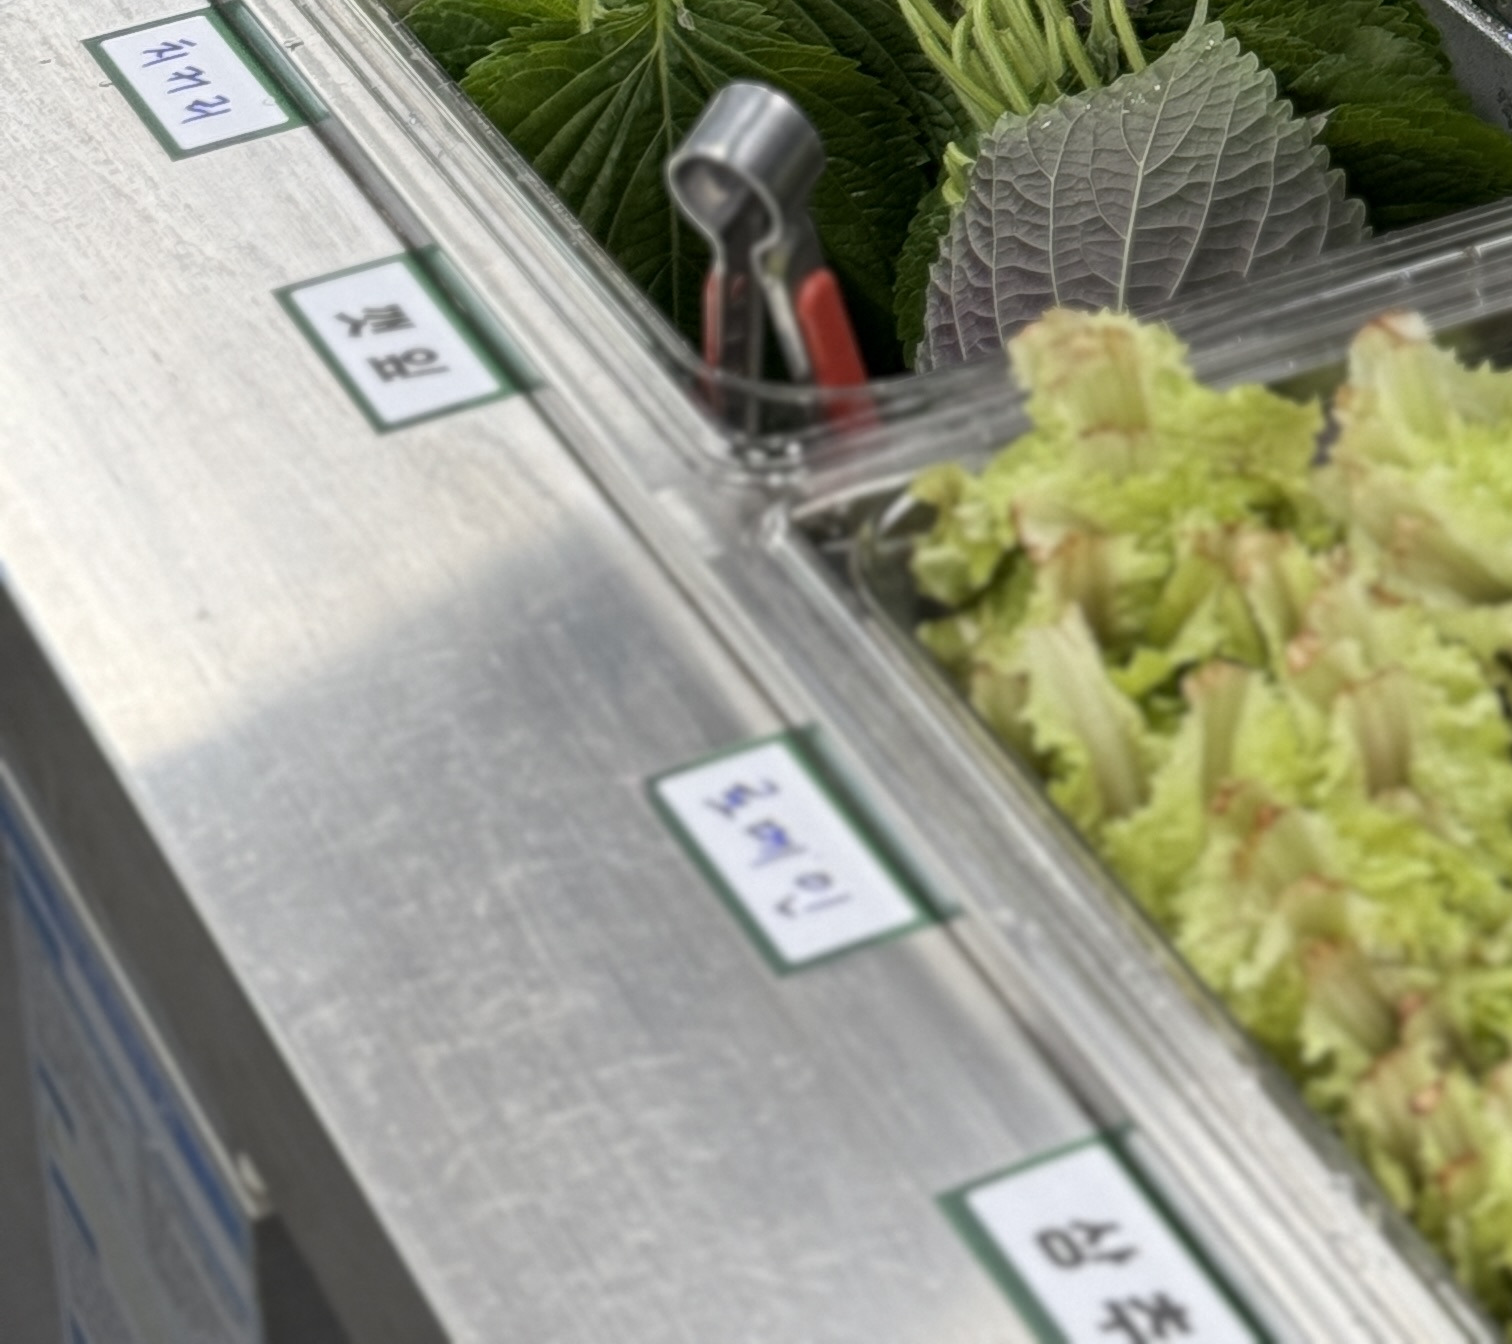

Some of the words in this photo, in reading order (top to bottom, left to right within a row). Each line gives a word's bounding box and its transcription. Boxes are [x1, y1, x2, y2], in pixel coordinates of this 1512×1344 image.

[142, 39, 231, 124] 치커리
[334, 303, 451, 383] 깻잎
[702, 777, 853, 920] 로메인
